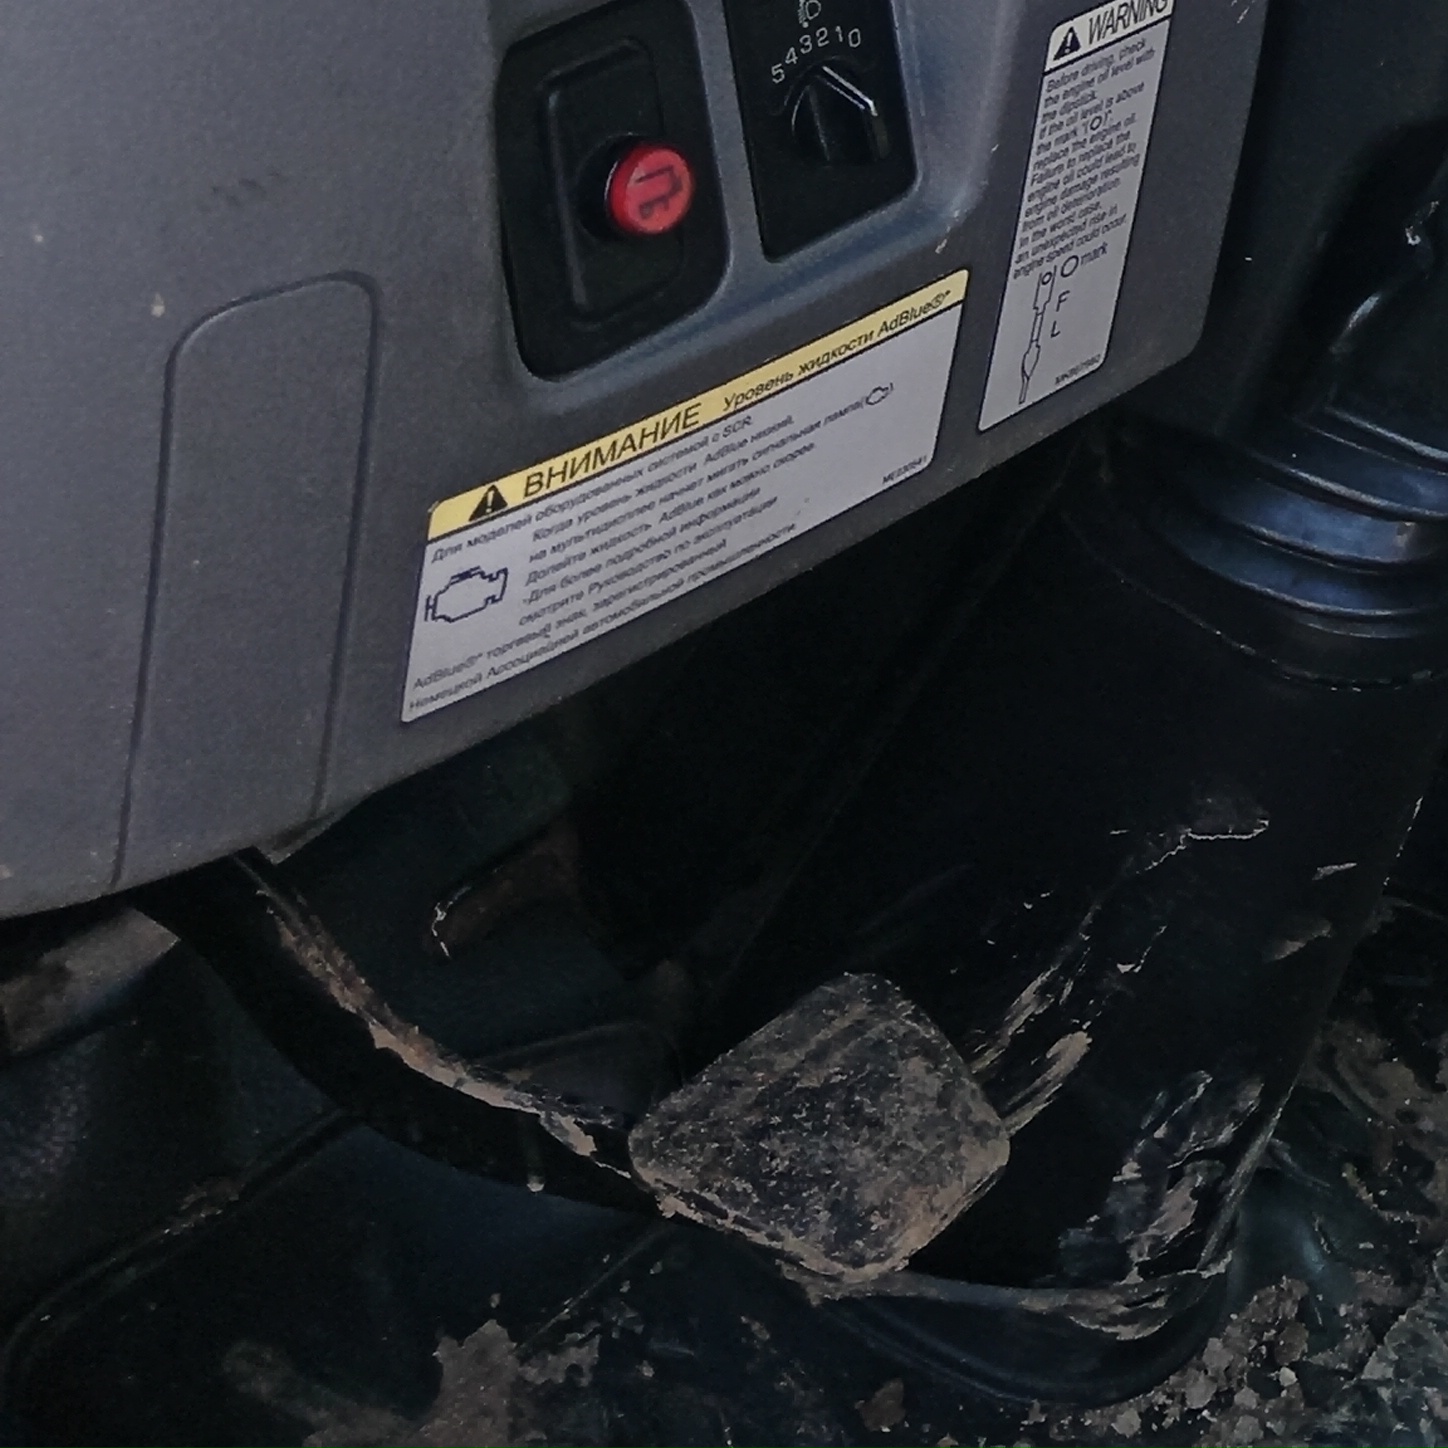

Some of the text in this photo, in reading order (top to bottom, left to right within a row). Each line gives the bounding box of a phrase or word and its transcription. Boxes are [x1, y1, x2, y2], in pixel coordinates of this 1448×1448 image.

[771, 25, 861, 84] 5 4 3 2 1 0
[1046, 70, 1079, 93] Before
[1055, 289, 1070, 312] F
[1049, 320, 1061, 338] L
[524, 403, 700, 497] ВНИМАНИЕ
[723, 372, 793, 411] Уровень
[798, 330, 874, 375] жидкости
[431, 543, 463, 564] Для
[466, 514, 532, 547] моделей
